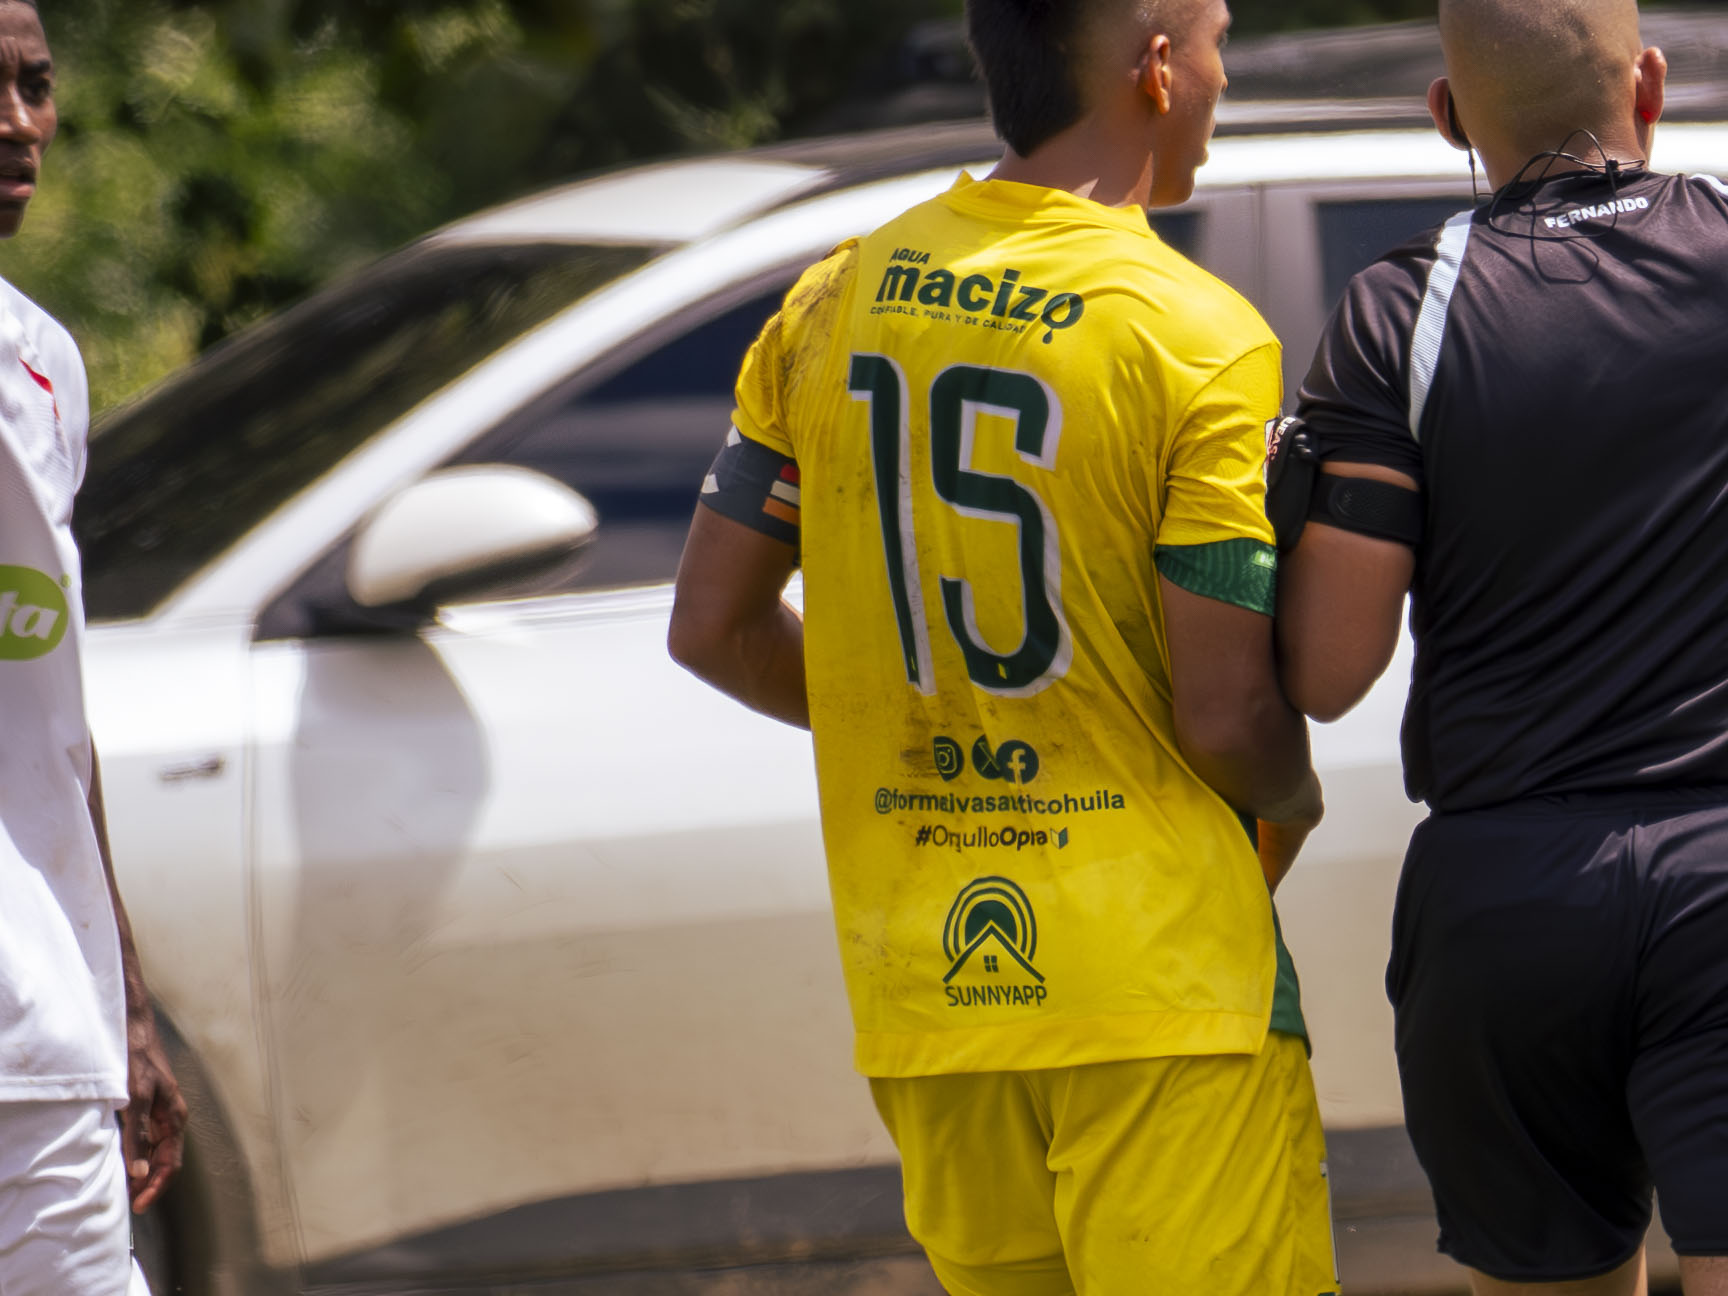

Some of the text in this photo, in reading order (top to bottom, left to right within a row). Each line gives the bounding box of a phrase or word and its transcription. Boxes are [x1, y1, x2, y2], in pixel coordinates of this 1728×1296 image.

[1543, 196, 1649, 228] FERNANDO
[889, 248, 931, 265] AGUA
[875, 267, 1085, 345] macizo
[924, 310, 950, 322] PURA
[964, 316, 979, 326] DE
[847, 352, 1074, 700] 15
[944, 985, 1048, 1008] SUNNYAPP
